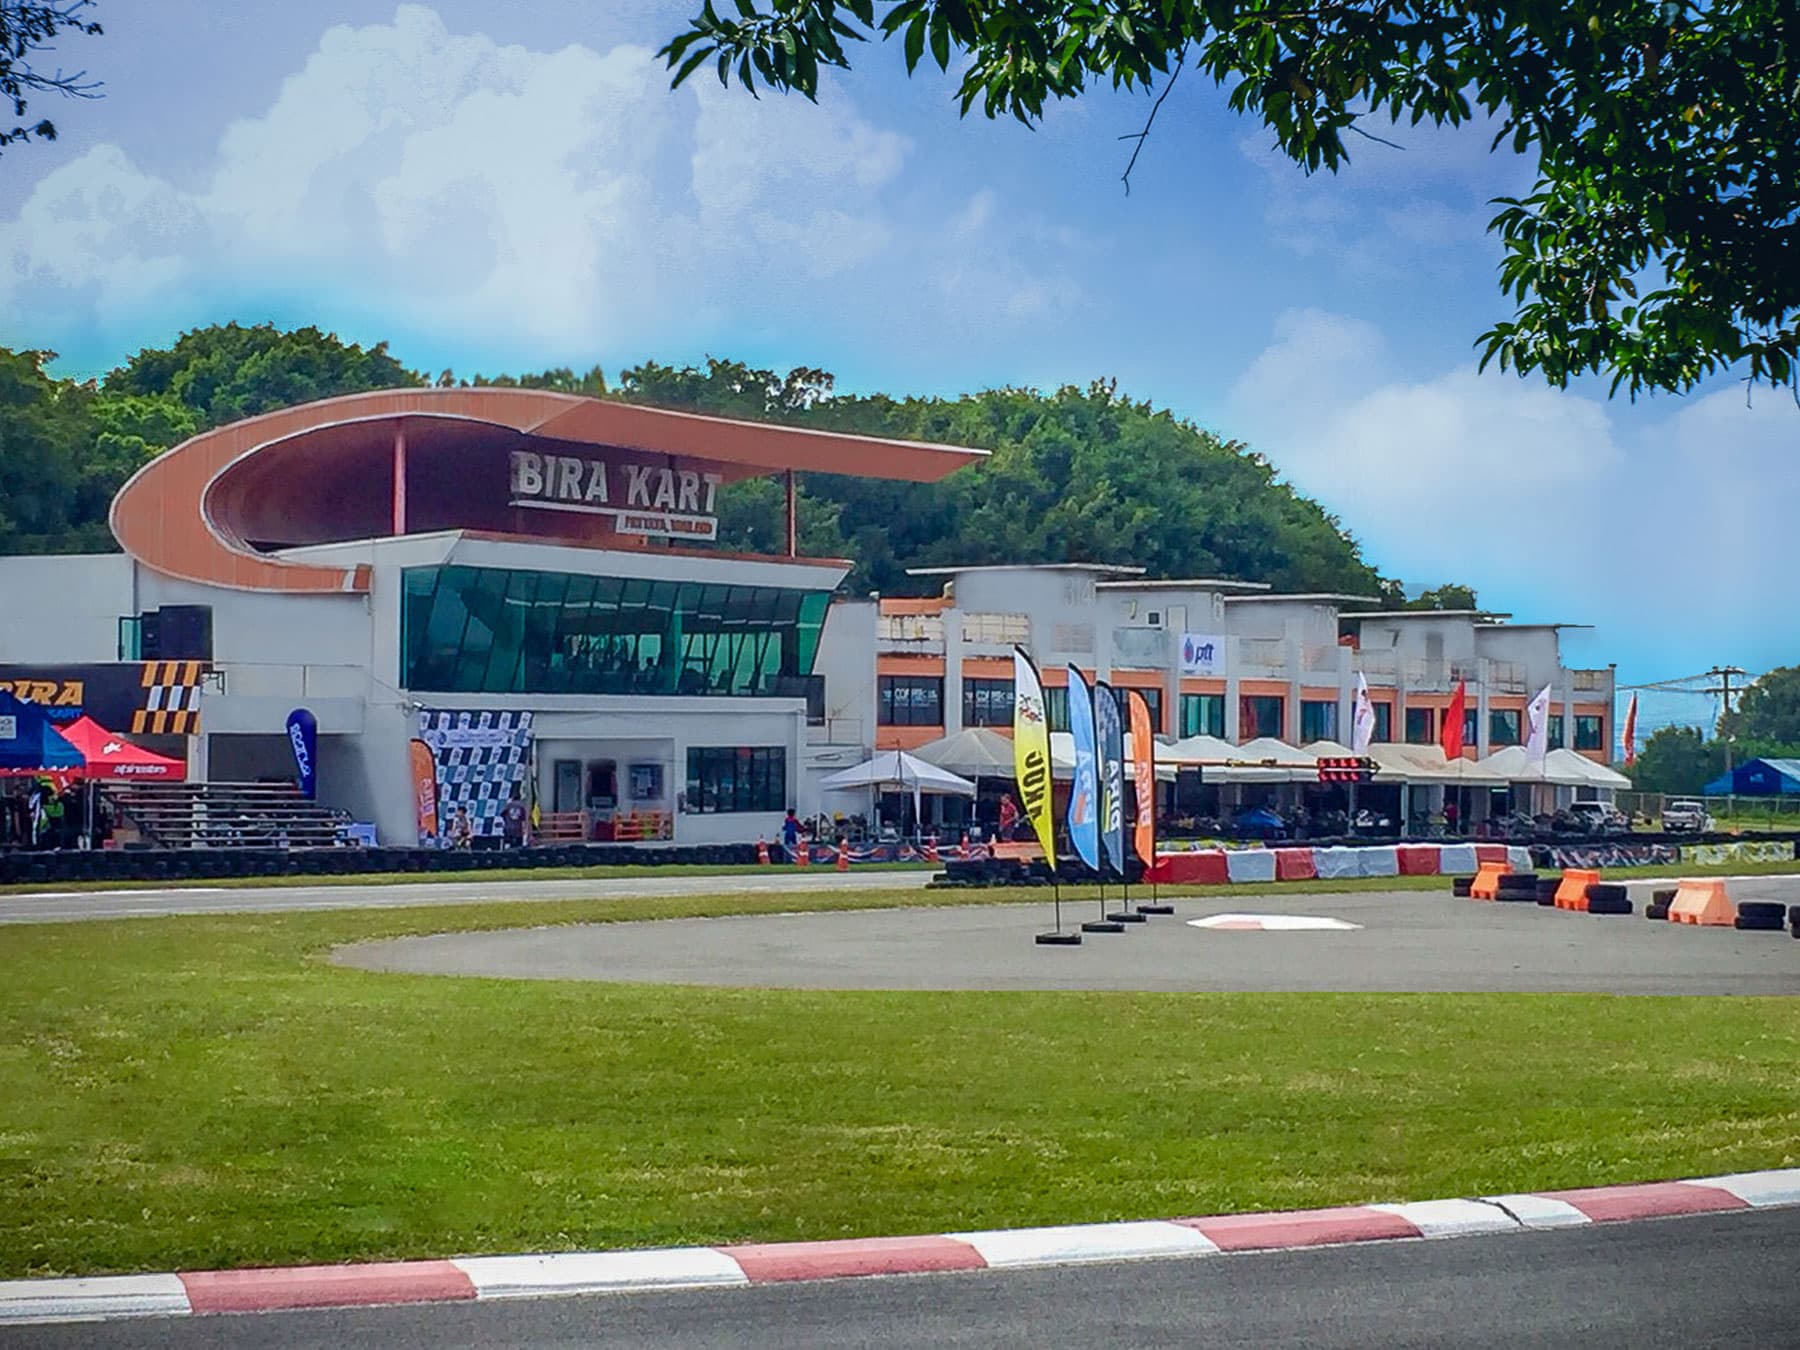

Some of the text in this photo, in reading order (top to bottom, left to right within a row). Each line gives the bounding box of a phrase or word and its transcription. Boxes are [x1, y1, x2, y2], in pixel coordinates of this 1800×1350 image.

[510, 450, 723, 512] BIRA KART
[1195, 642, 1214, 664] ptt
